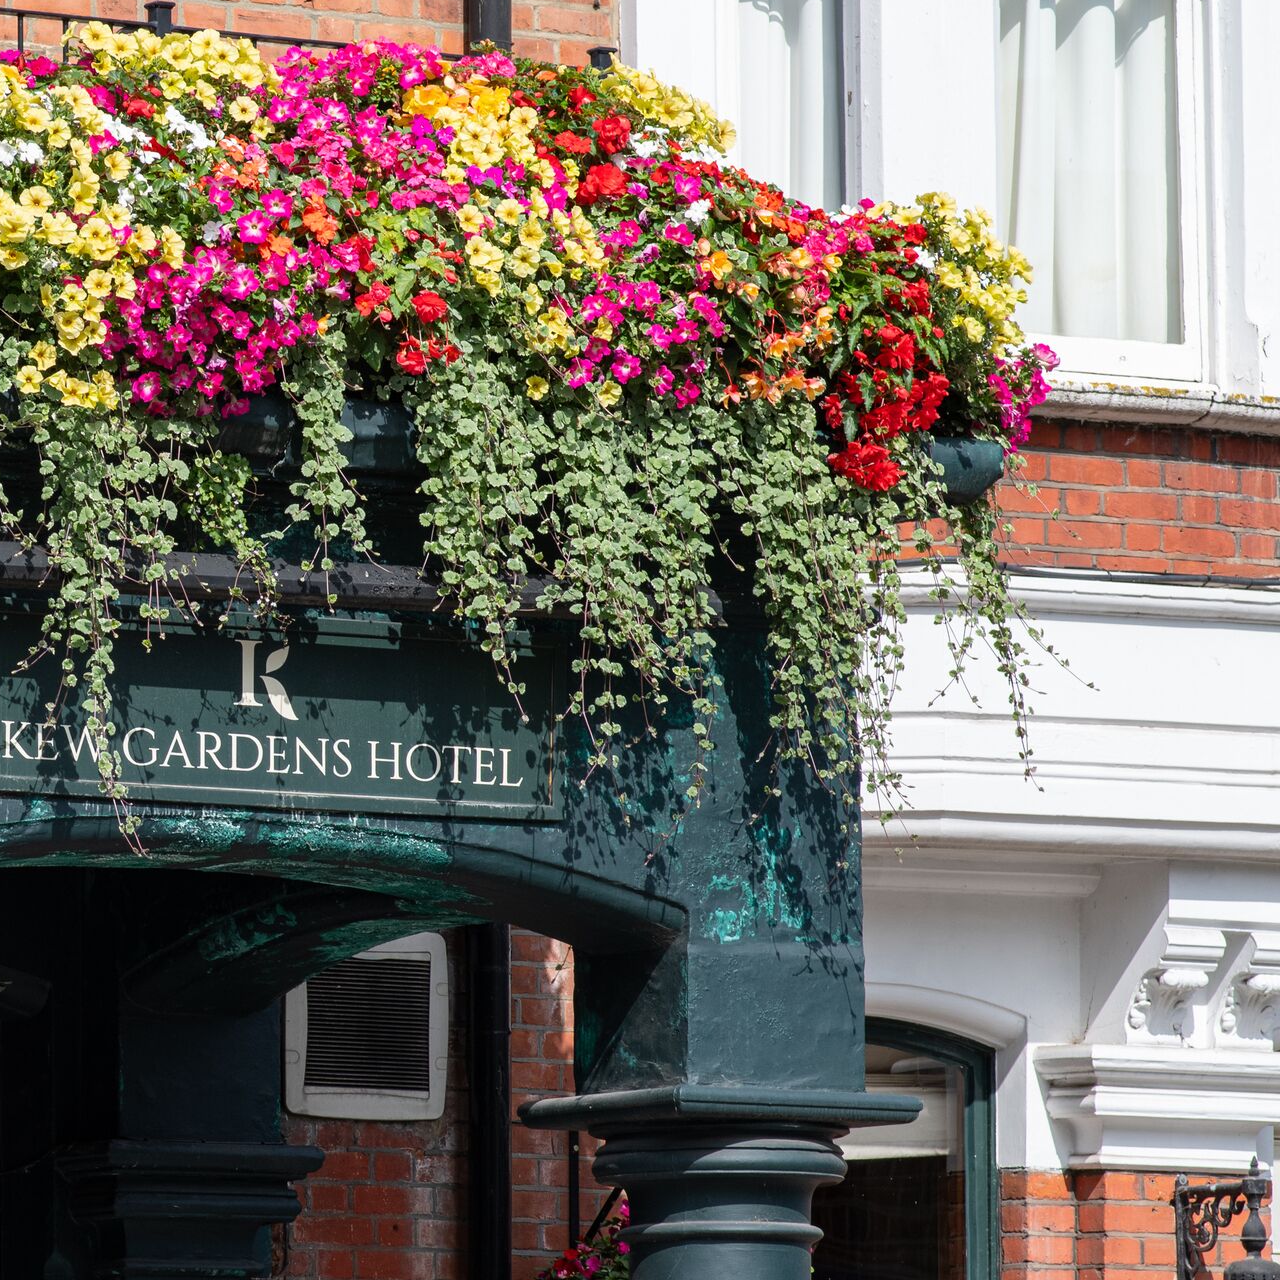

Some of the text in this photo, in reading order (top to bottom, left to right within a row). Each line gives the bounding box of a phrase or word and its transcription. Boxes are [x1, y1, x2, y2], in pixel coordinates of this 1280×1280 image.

[1, 720, 524, 788] KEW GARDENS HOTEL
